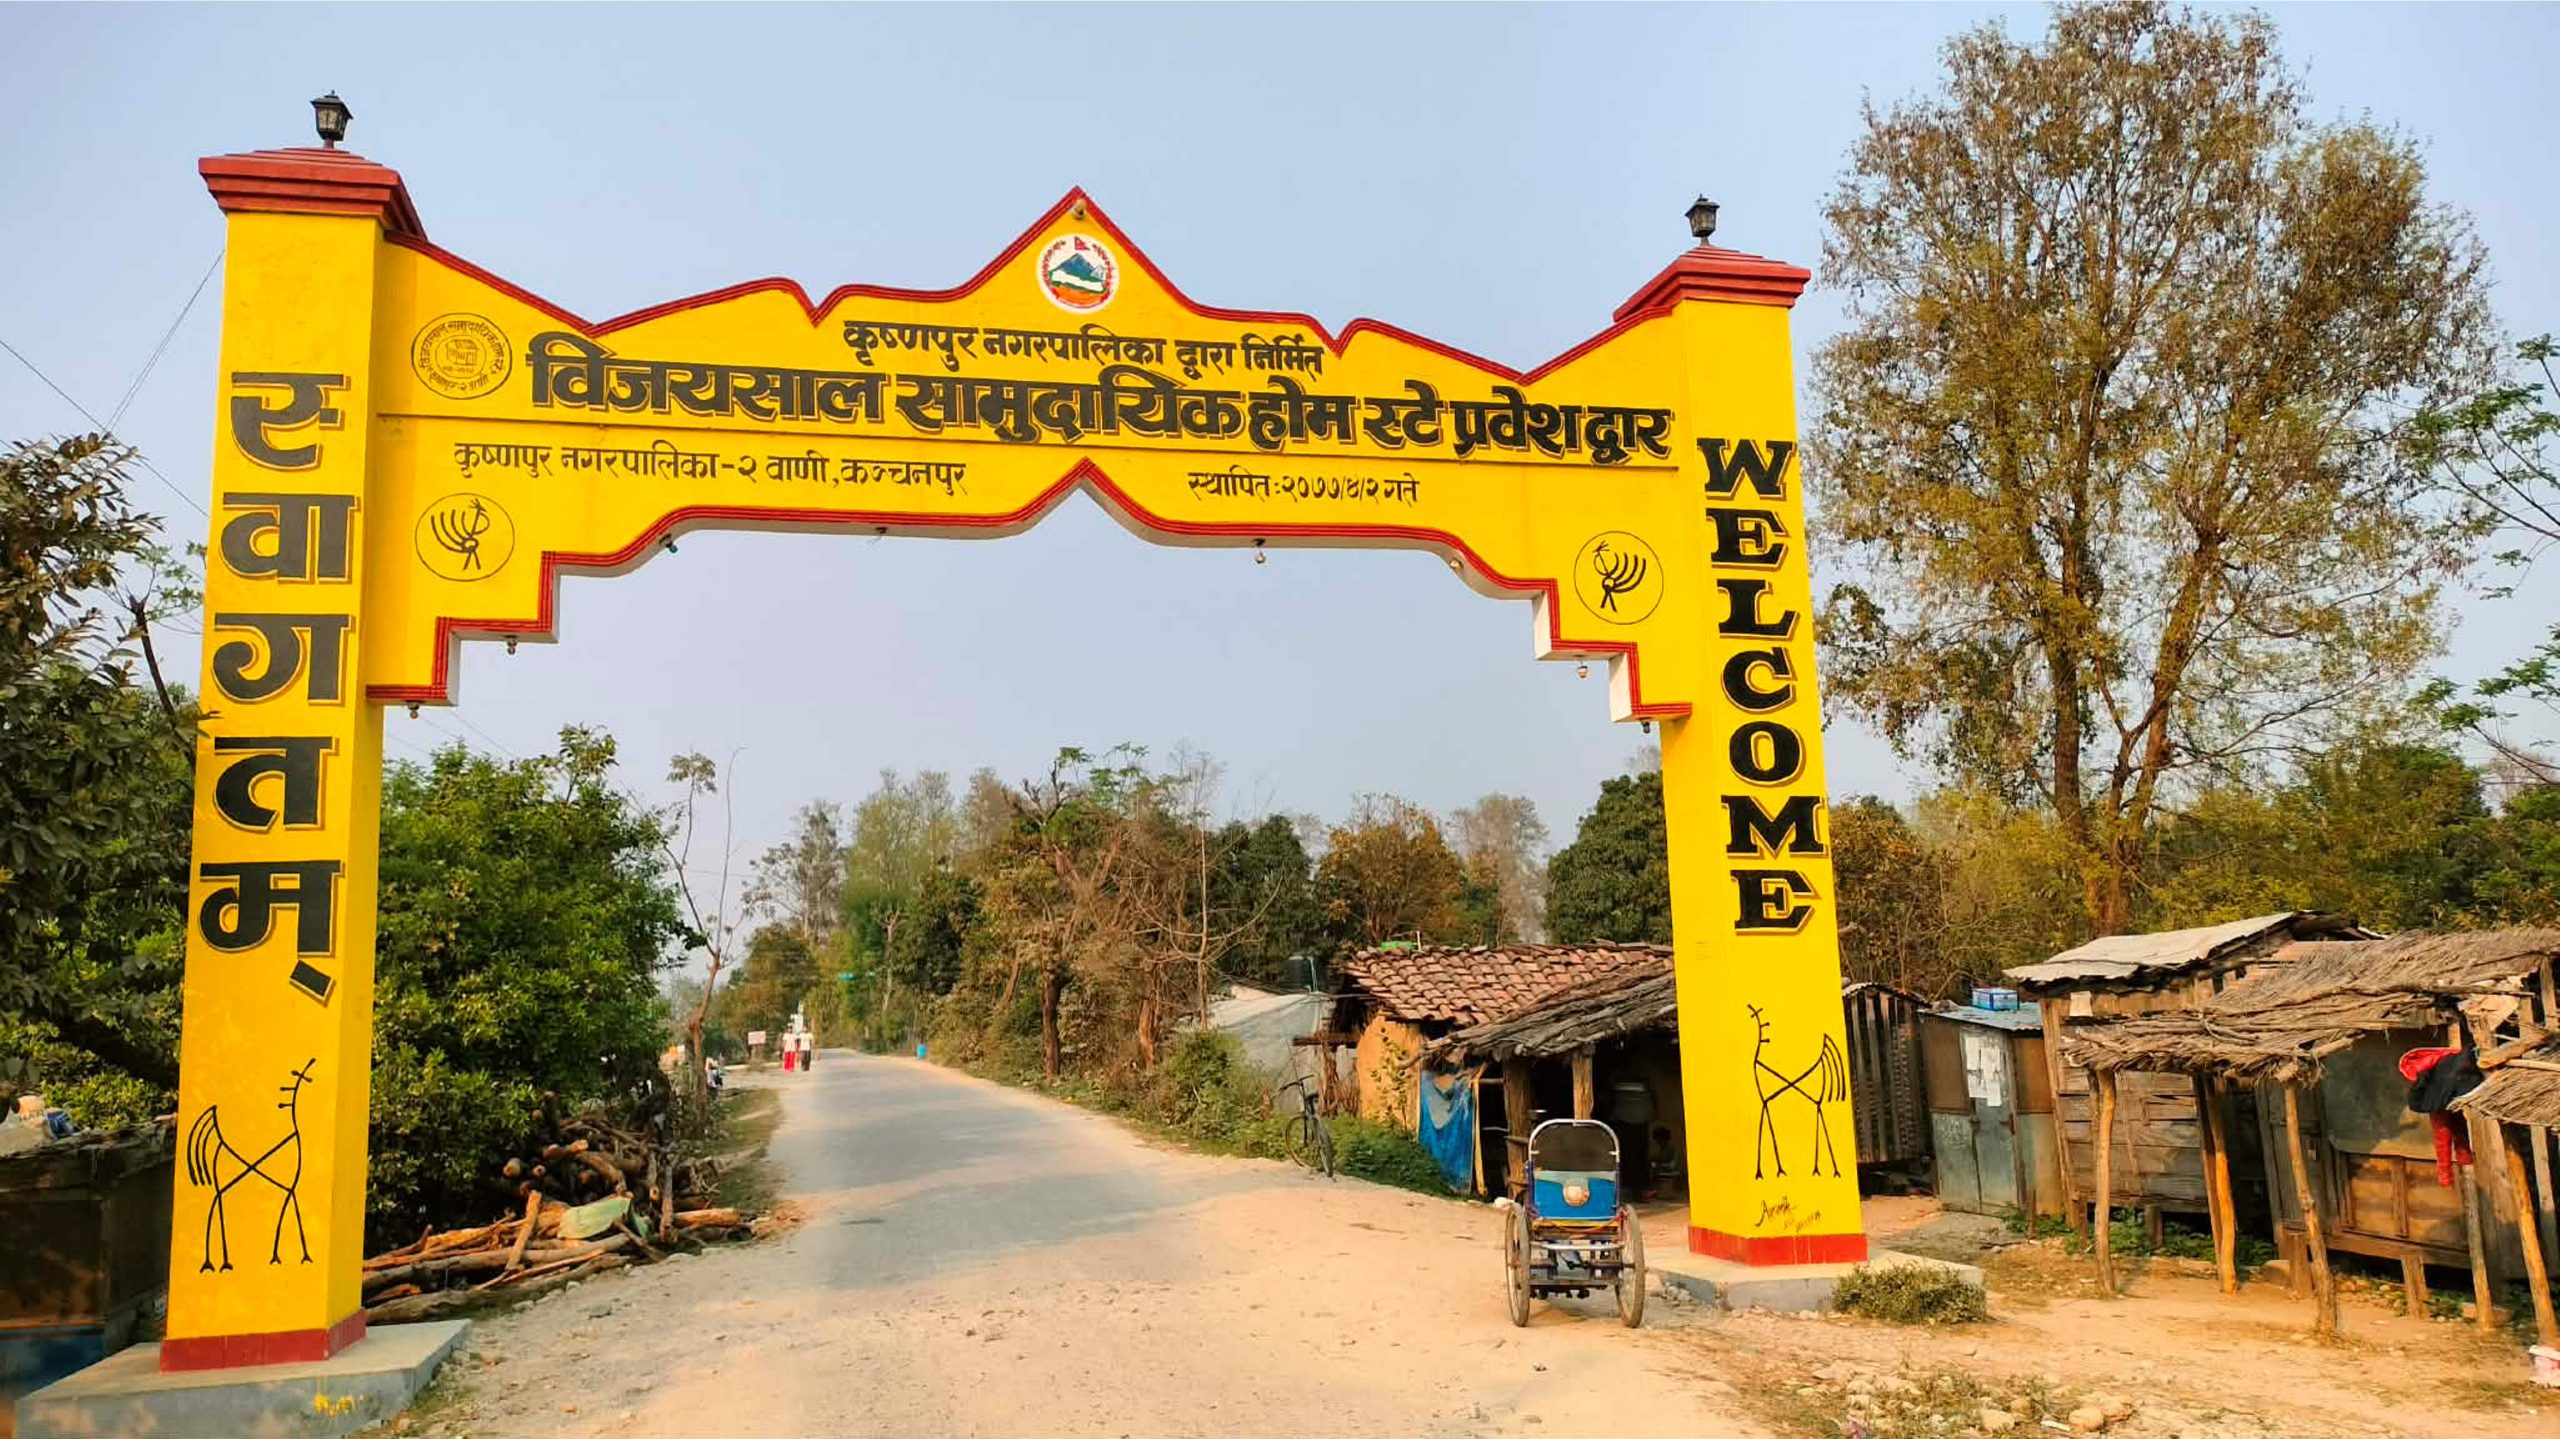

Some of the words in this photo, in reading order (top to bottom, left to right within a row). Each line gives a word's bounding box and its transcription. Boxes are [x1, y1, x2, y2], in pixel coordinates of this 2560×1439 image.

[843, 320, 978, 372] कृष्णपुर
[983, 324, 1164, 366] नगरपालिका
[1175, 339, 1236, 379] द्वारा
[1240, 333, 1324, 376] निर्मित
[526, 331, 889, 423] विजयसाल
[895, 364, 1246, 444] सामुदायिक
[1247, 375, 1360, 452] होम
[1362, 379, 1449, 446] स्टे
[1449, 385, 1585, 458] प्रवेश
[1586, 405, 1675, 463] द्वार
[454, 442, 553, 478] कृष्णपुर
[1384, 472, 1420, 507] गते
[1696, 437, 1829, 935] WELCOME
